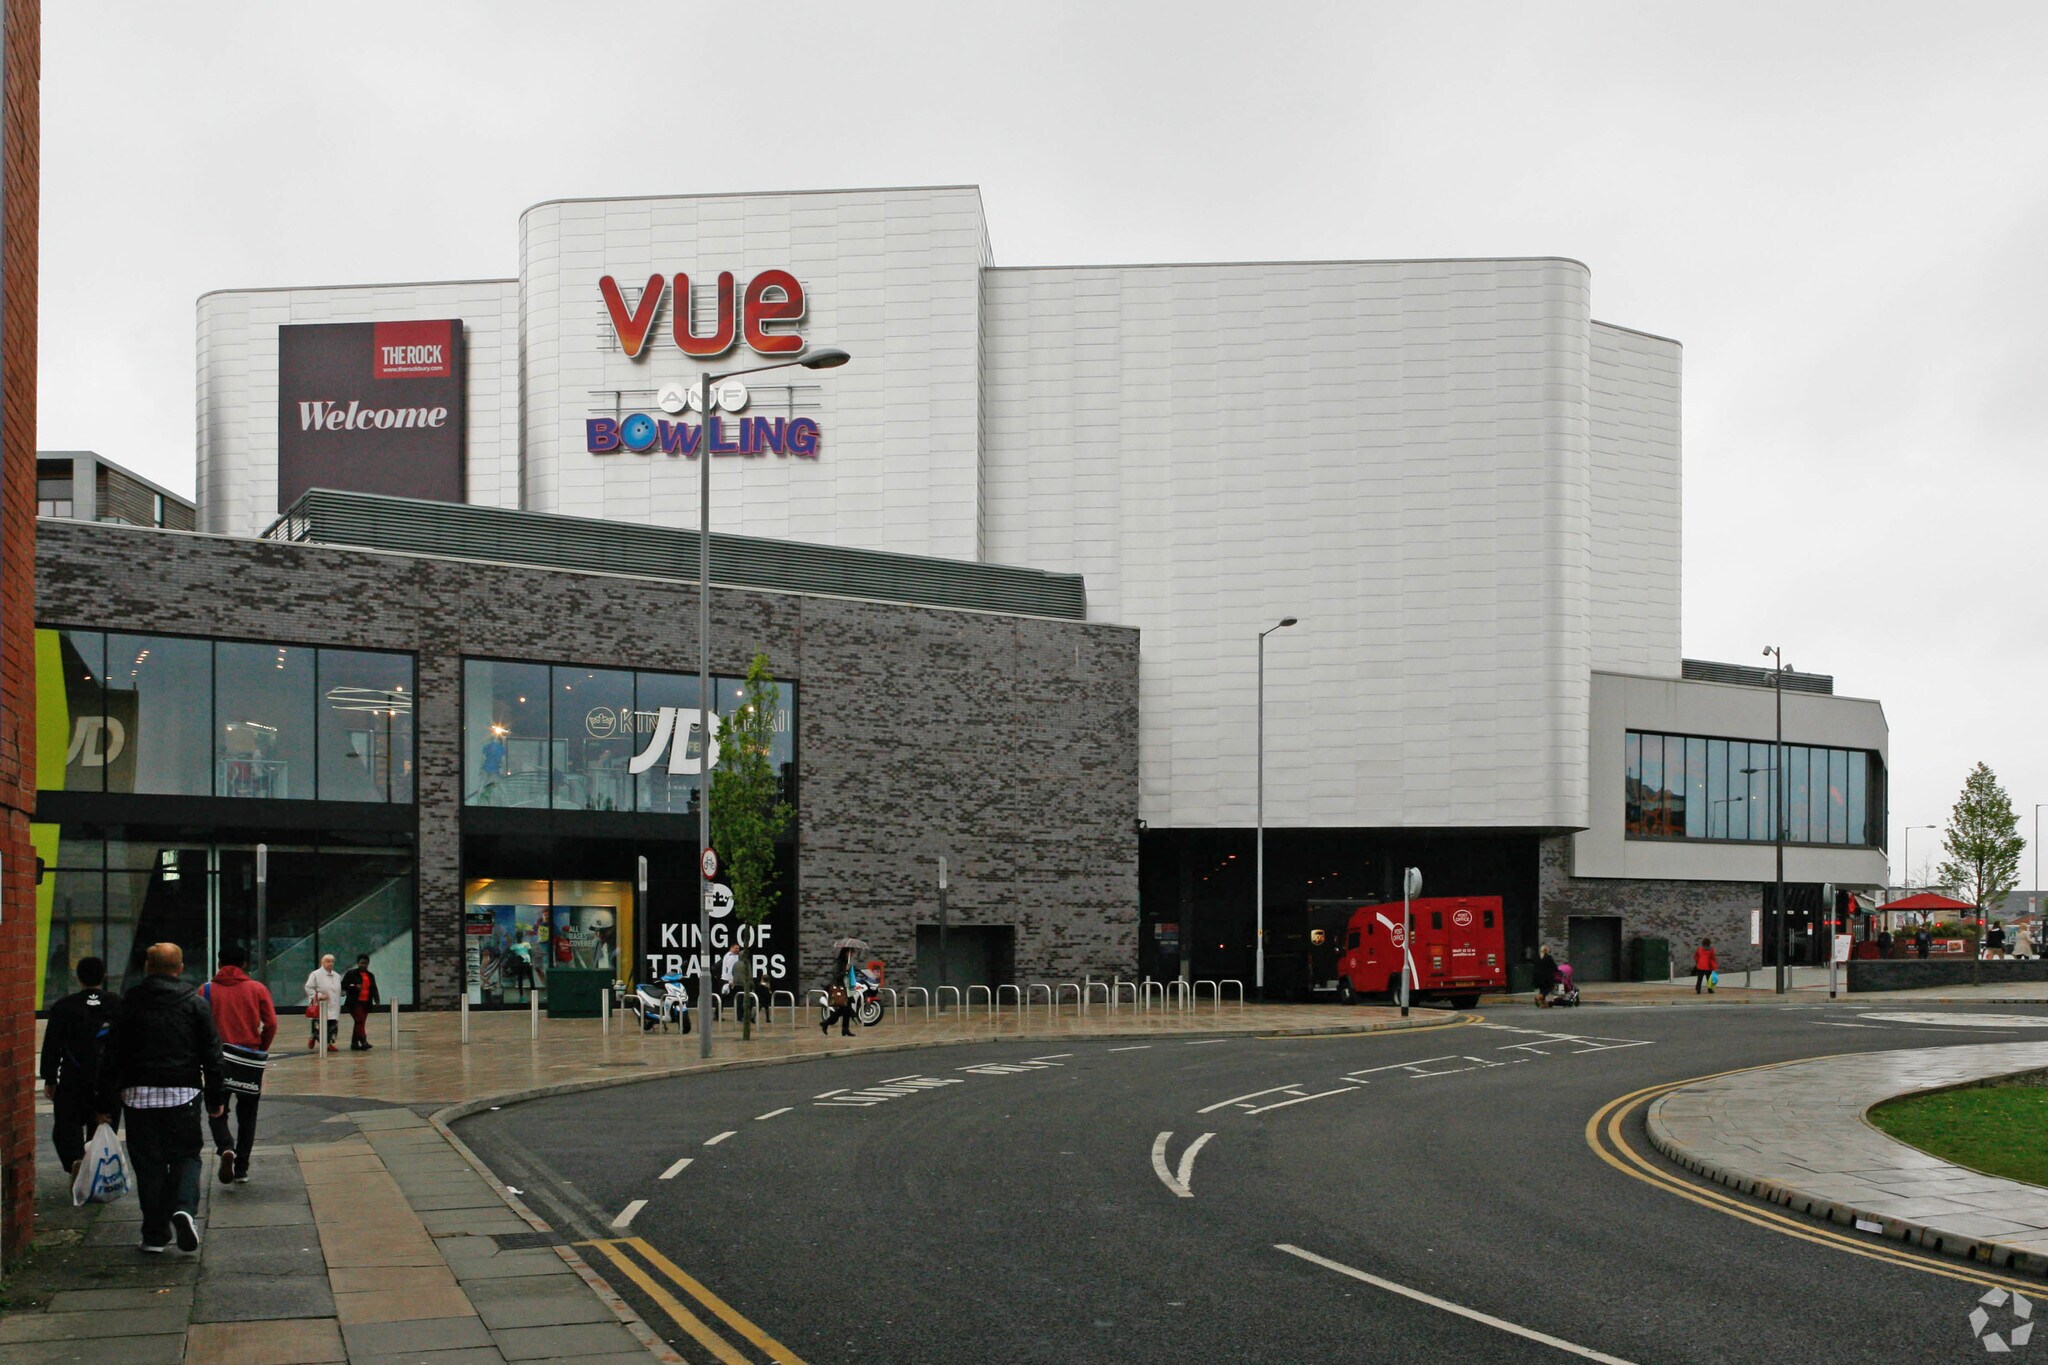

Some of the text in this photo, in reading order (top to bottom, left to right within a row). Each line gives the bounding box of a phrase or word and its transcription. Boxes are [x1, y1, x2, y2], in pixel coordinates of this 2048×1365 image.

[598, 269, 806, 358] vue
[382, 344, 443, 365] THE ROCK
[382, 365, 444, 373] www.therockbury.com
[298, 400, 448, 431] Welcome
[586, 412, 820, 458] BOWLING
[628, 706, 721, 775] JD
[661, 923, 772, 948] KING OF
[647, 954, 786, 979] TRARS
